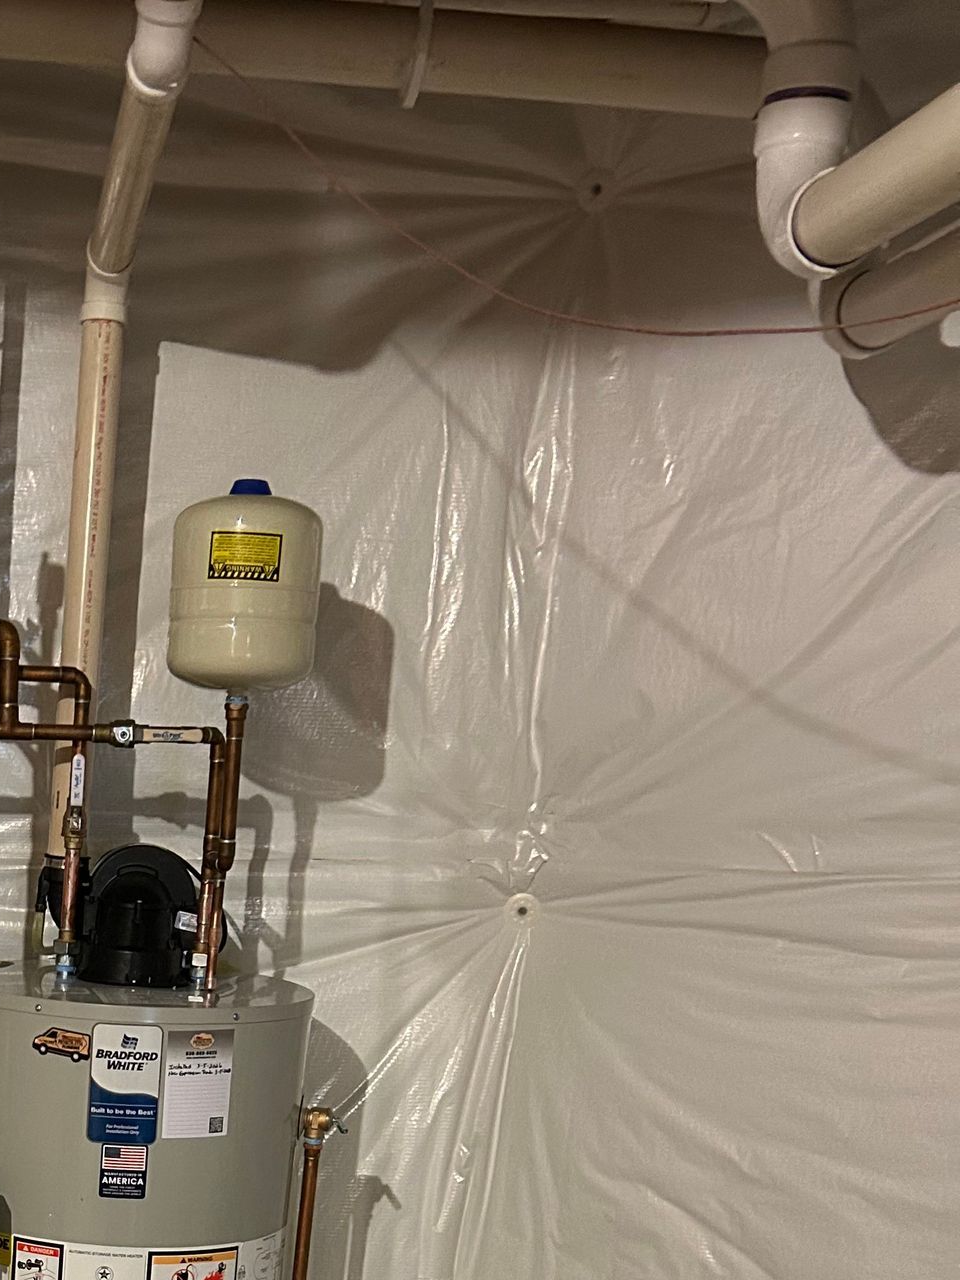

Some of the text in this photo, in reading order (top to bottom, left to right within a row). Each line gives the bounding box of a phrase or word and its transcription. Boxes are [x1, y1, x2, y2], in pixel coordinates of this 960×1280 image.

[96, 1049, 159, 1061] BRADFORD
[107, 1060, 145, 1072] WHITE
[90, 1106, 106, 1114] Built
[101, 1176, 144, 1185] AMERICA
[30, 1247, 54, 1256] DANGER
